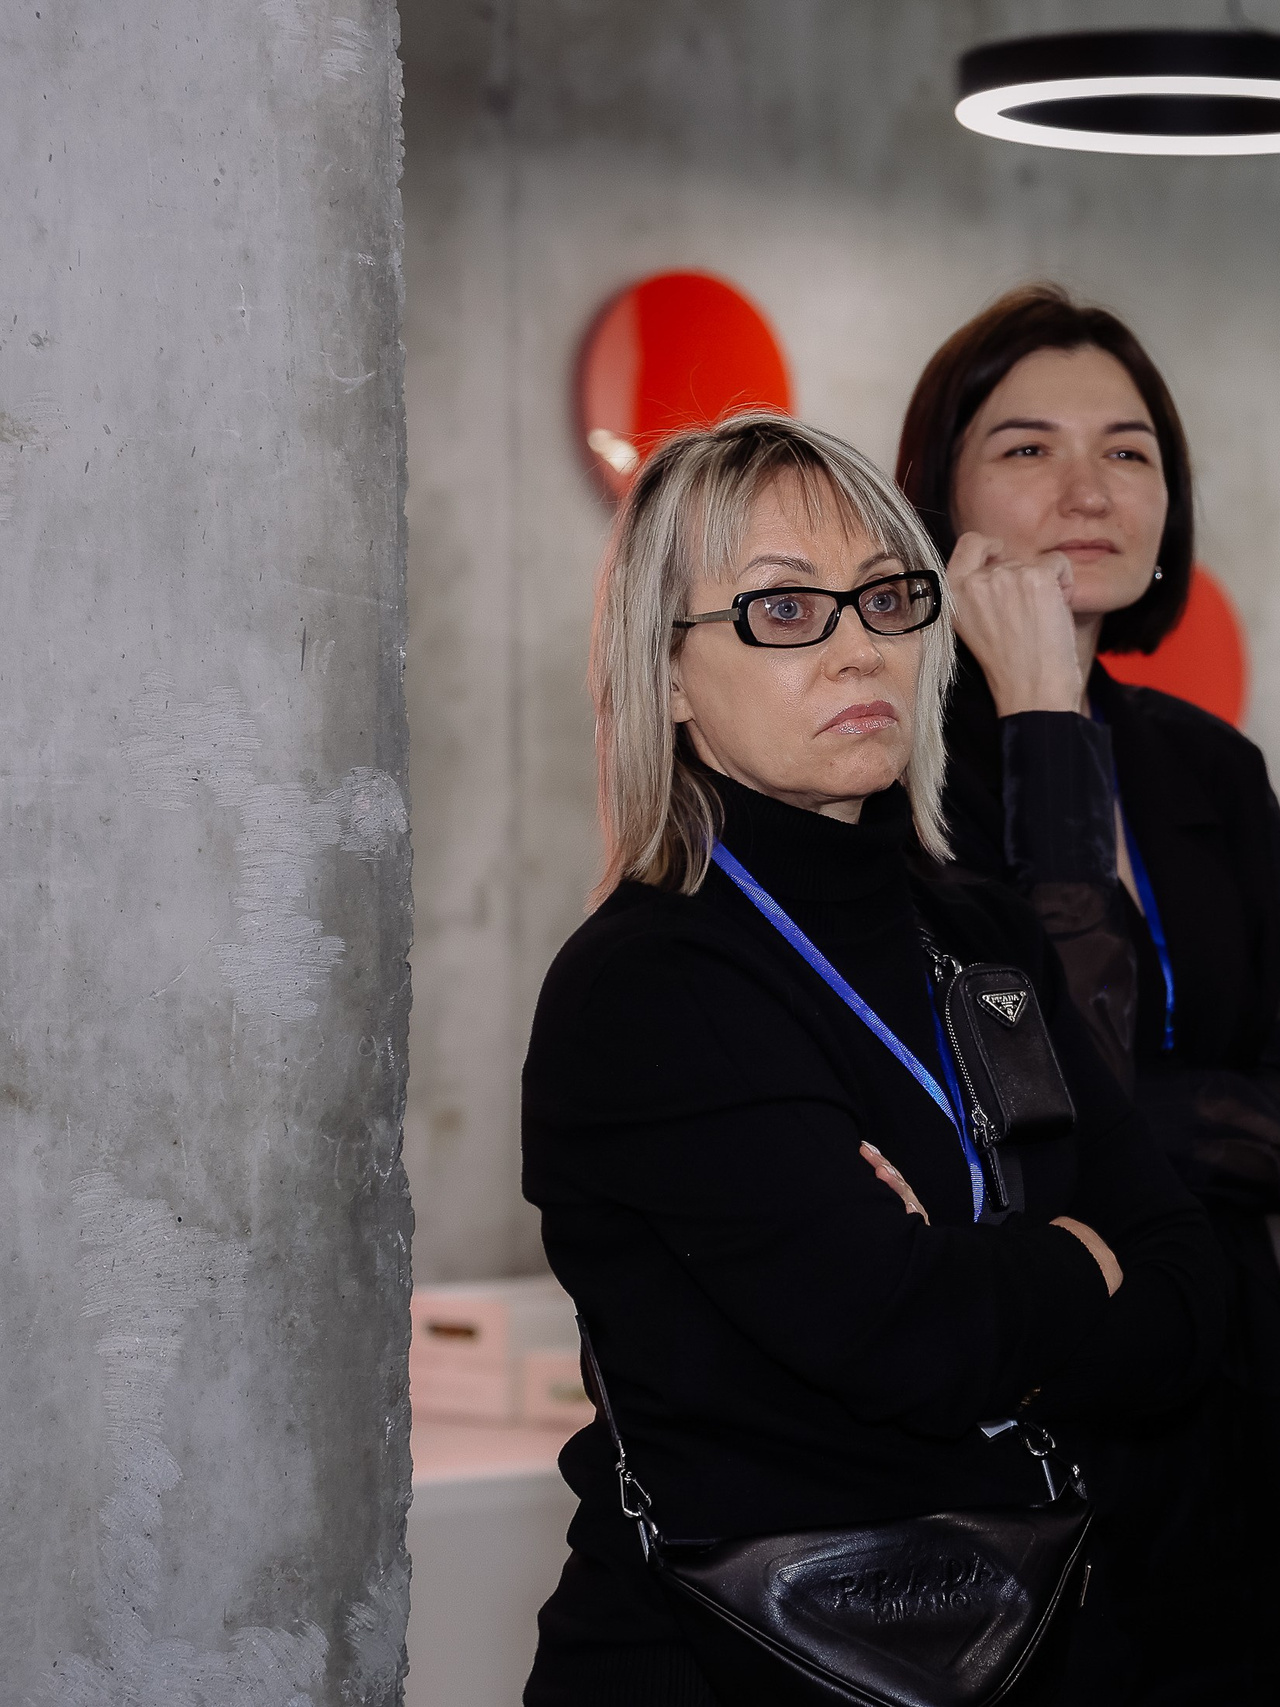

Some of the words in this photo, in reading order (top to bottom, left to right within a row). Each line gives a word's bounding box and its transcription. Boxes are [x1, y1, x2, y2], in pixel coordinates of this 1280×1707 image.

[990, 994, 1020, 1004] PRADA
[829, 1552, 999, 1608] PRADA
[869, 1591, 971, 1624] MILANO
